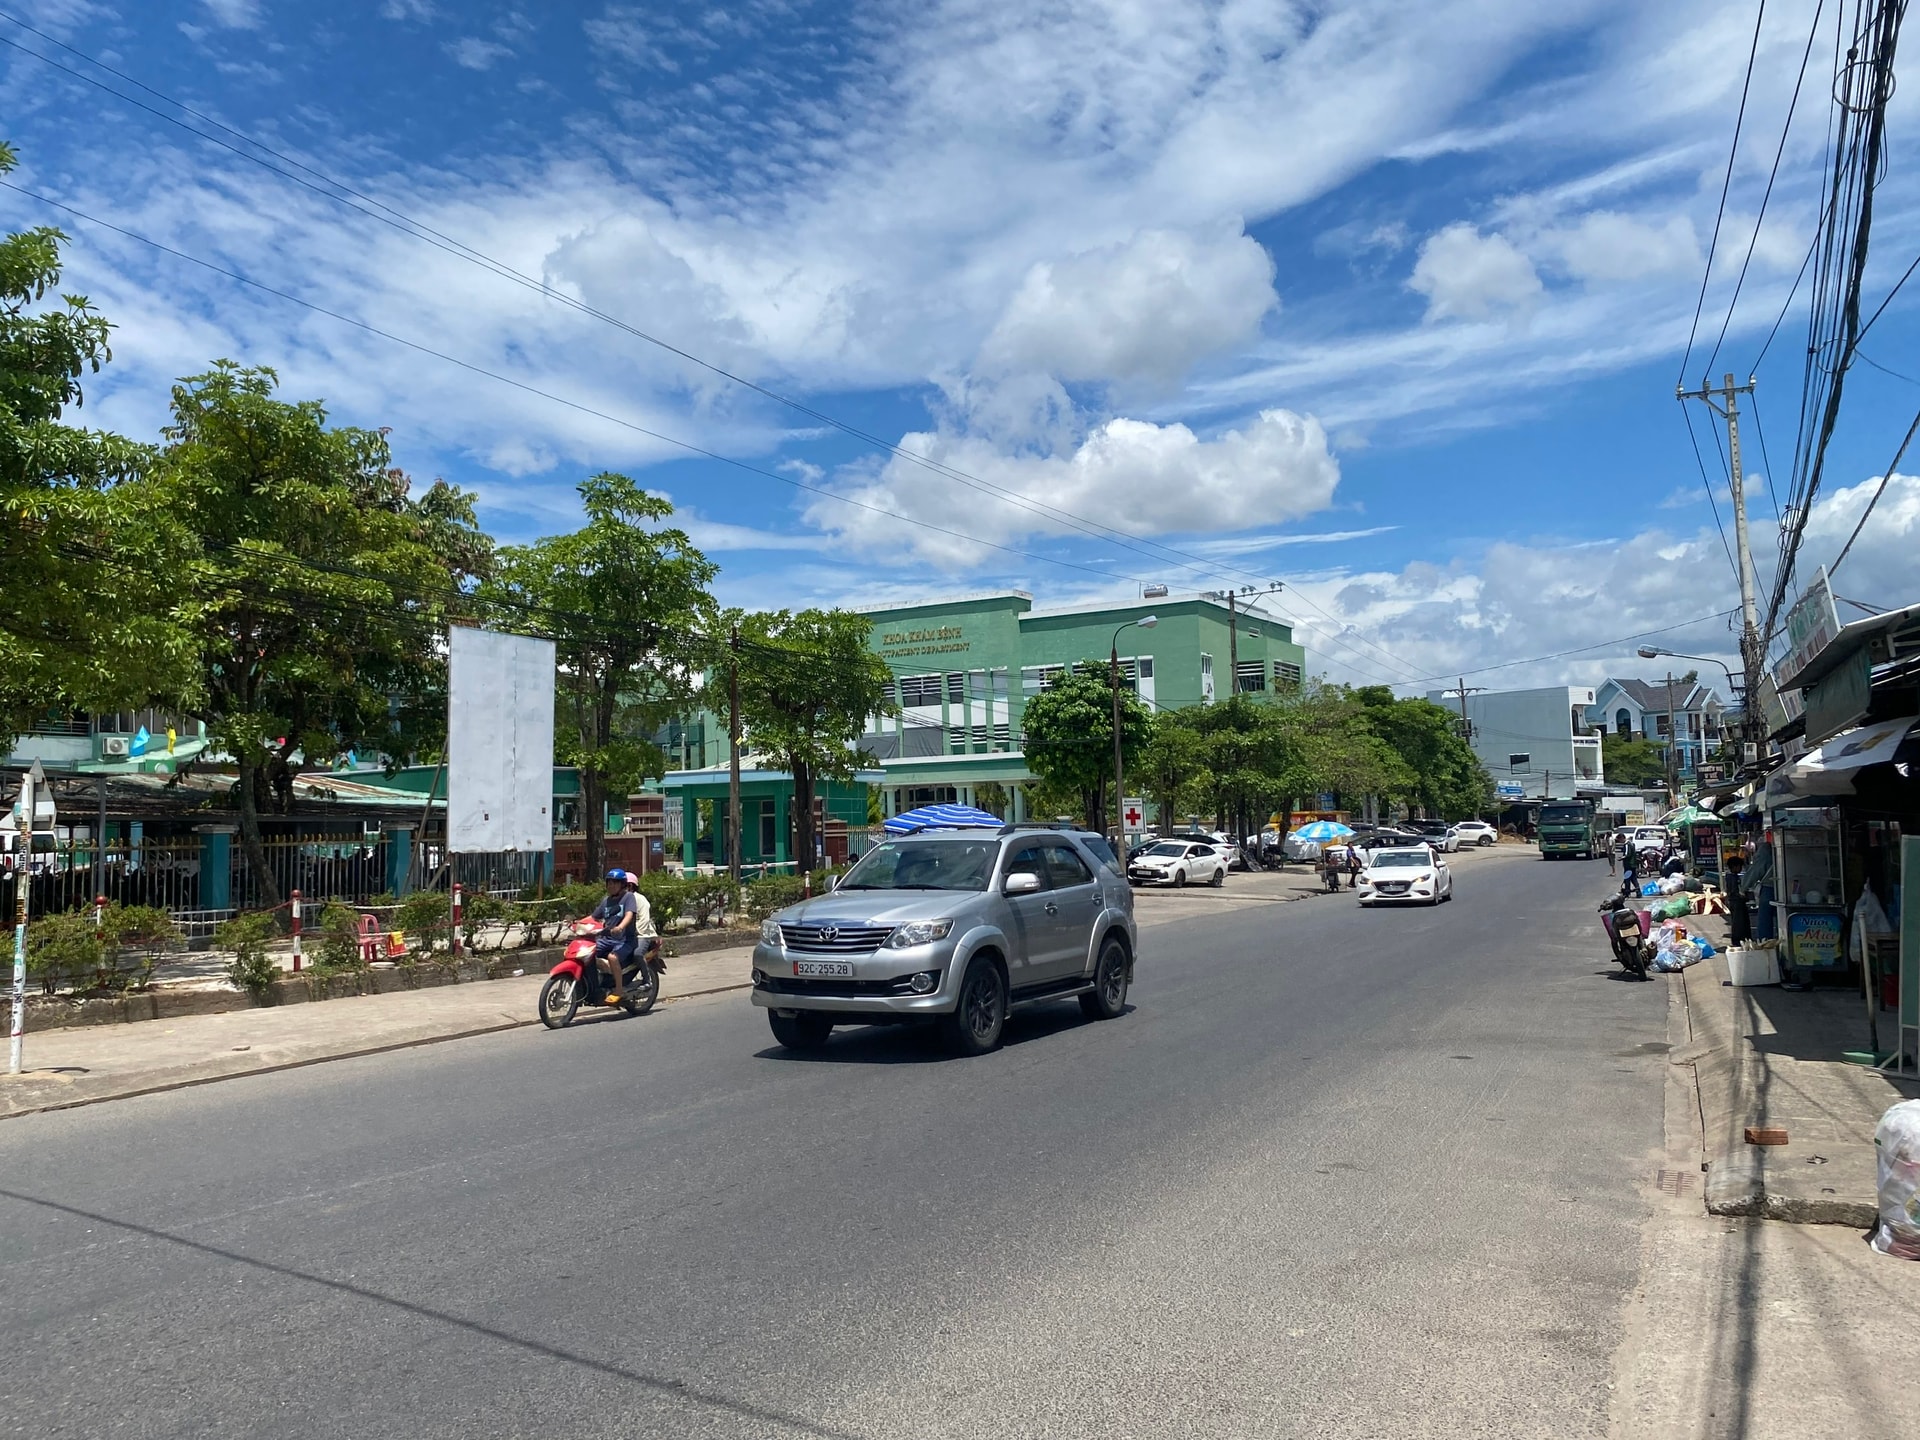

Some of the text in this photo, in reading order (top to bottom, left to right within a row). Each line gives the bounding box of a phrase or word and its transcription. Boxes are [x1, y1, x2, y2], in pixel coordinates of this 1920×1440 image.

[882, 633, 908, 646] KHOA
[909, 628, 935, 643] KHÁM
[921, 642, 970, 655] DEPARTMENT
[798, 963, 848, 975] 92C-255.28
